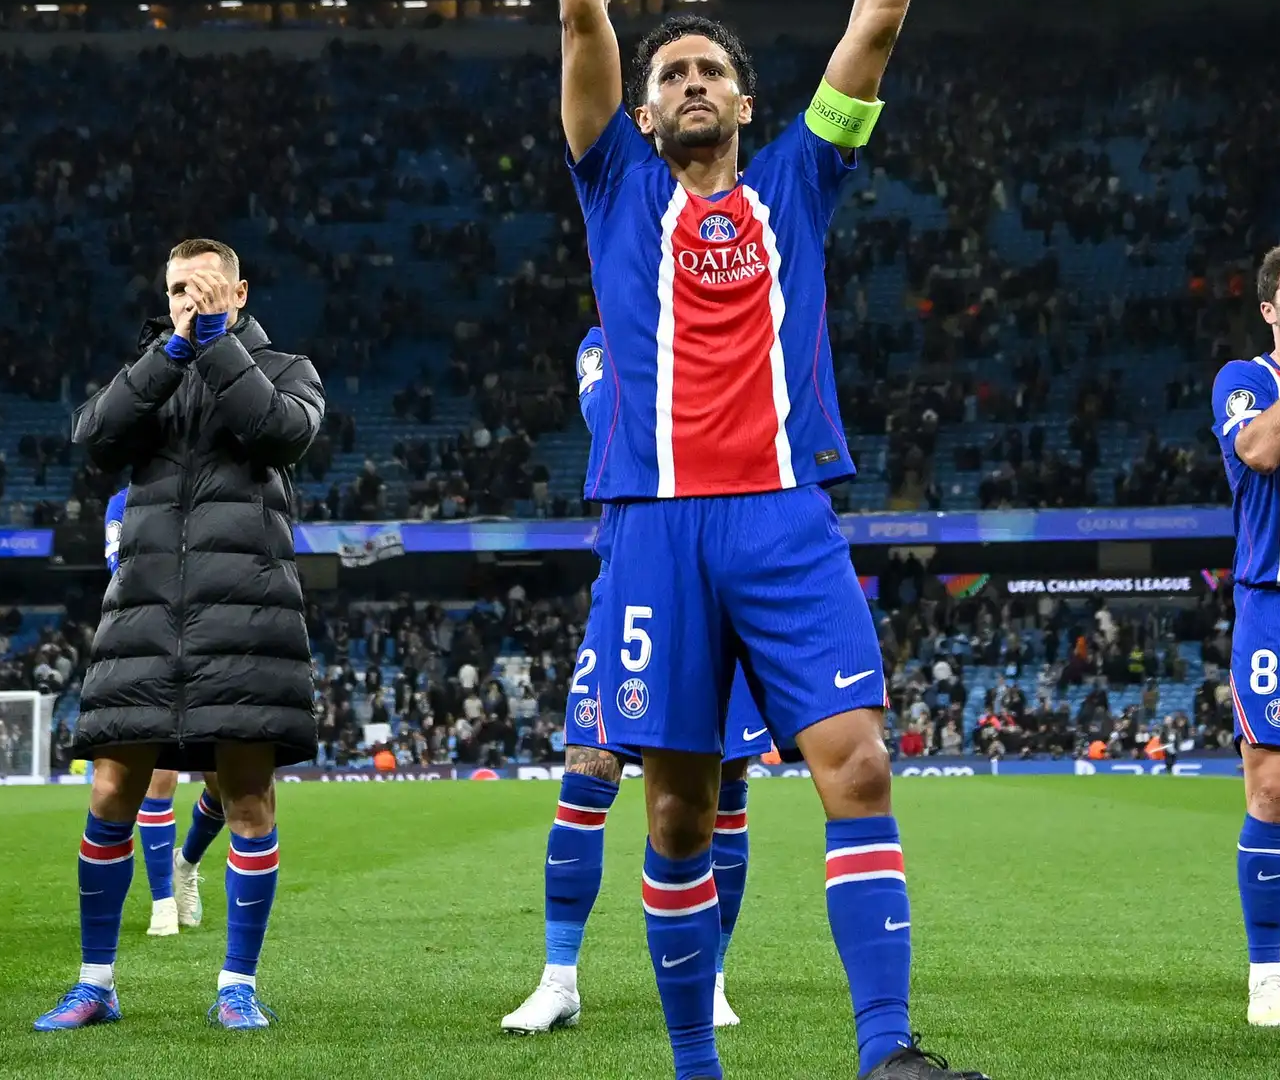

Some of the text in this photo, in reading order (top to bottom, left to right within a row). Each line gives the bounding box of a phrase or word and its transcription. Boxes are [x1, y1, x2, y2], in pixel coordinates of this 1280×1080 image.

[705, 217, 729, 227] PARIS
[678, 242, 760, 275] QATAR
[700, 261, 766, 284] AIRWAYS
[869, 522, 928, 537] PEPSI
[1007, 577, 1192, 593] UEFA CHAMPIONS LEAGUE
[620, 605, 653, 673] 5
[570, 648, 597, 694] 2
